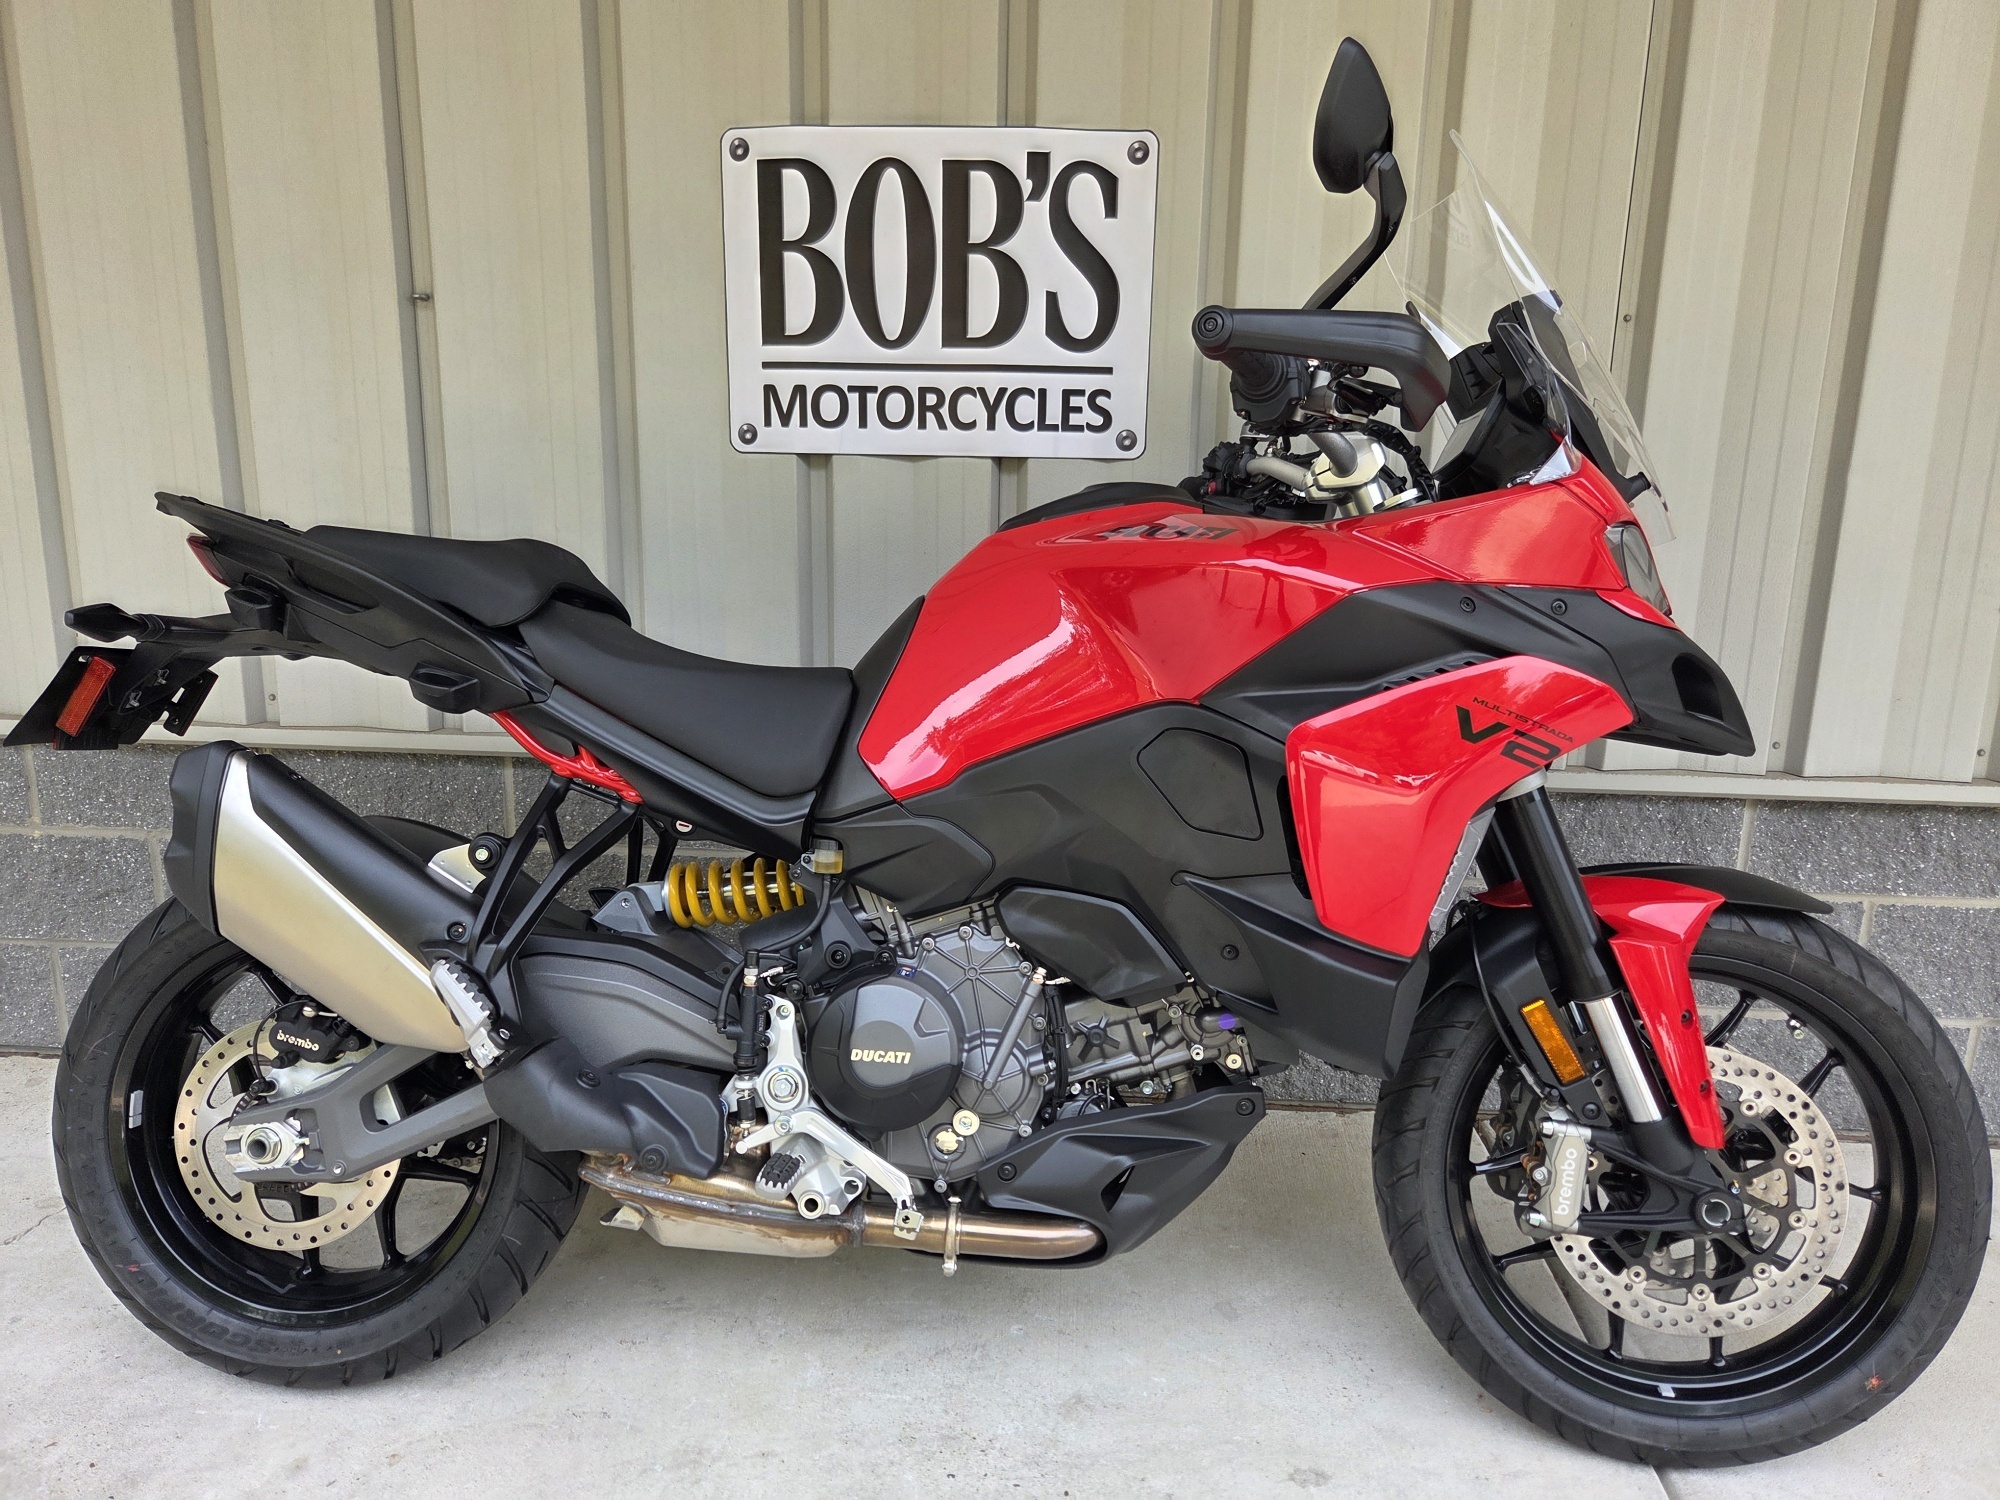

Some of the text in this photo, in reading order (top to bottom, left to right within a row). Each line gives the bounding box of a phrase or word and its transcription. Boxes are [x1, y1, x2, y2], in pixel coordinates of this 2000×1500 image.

[757, 151, 1120, 353] BOB'S
[762, 384, 1113, 433] MOTORCYCLES
[1456, 705, 1562, 769] V2
[1472, 696, 1574, 744] MULTISTRADA
[276, 1029, 320, 1051] brembo
[850, 1048, 912, 1064] DUCATI
[1553, 1148, 1578, 1216] brembo
